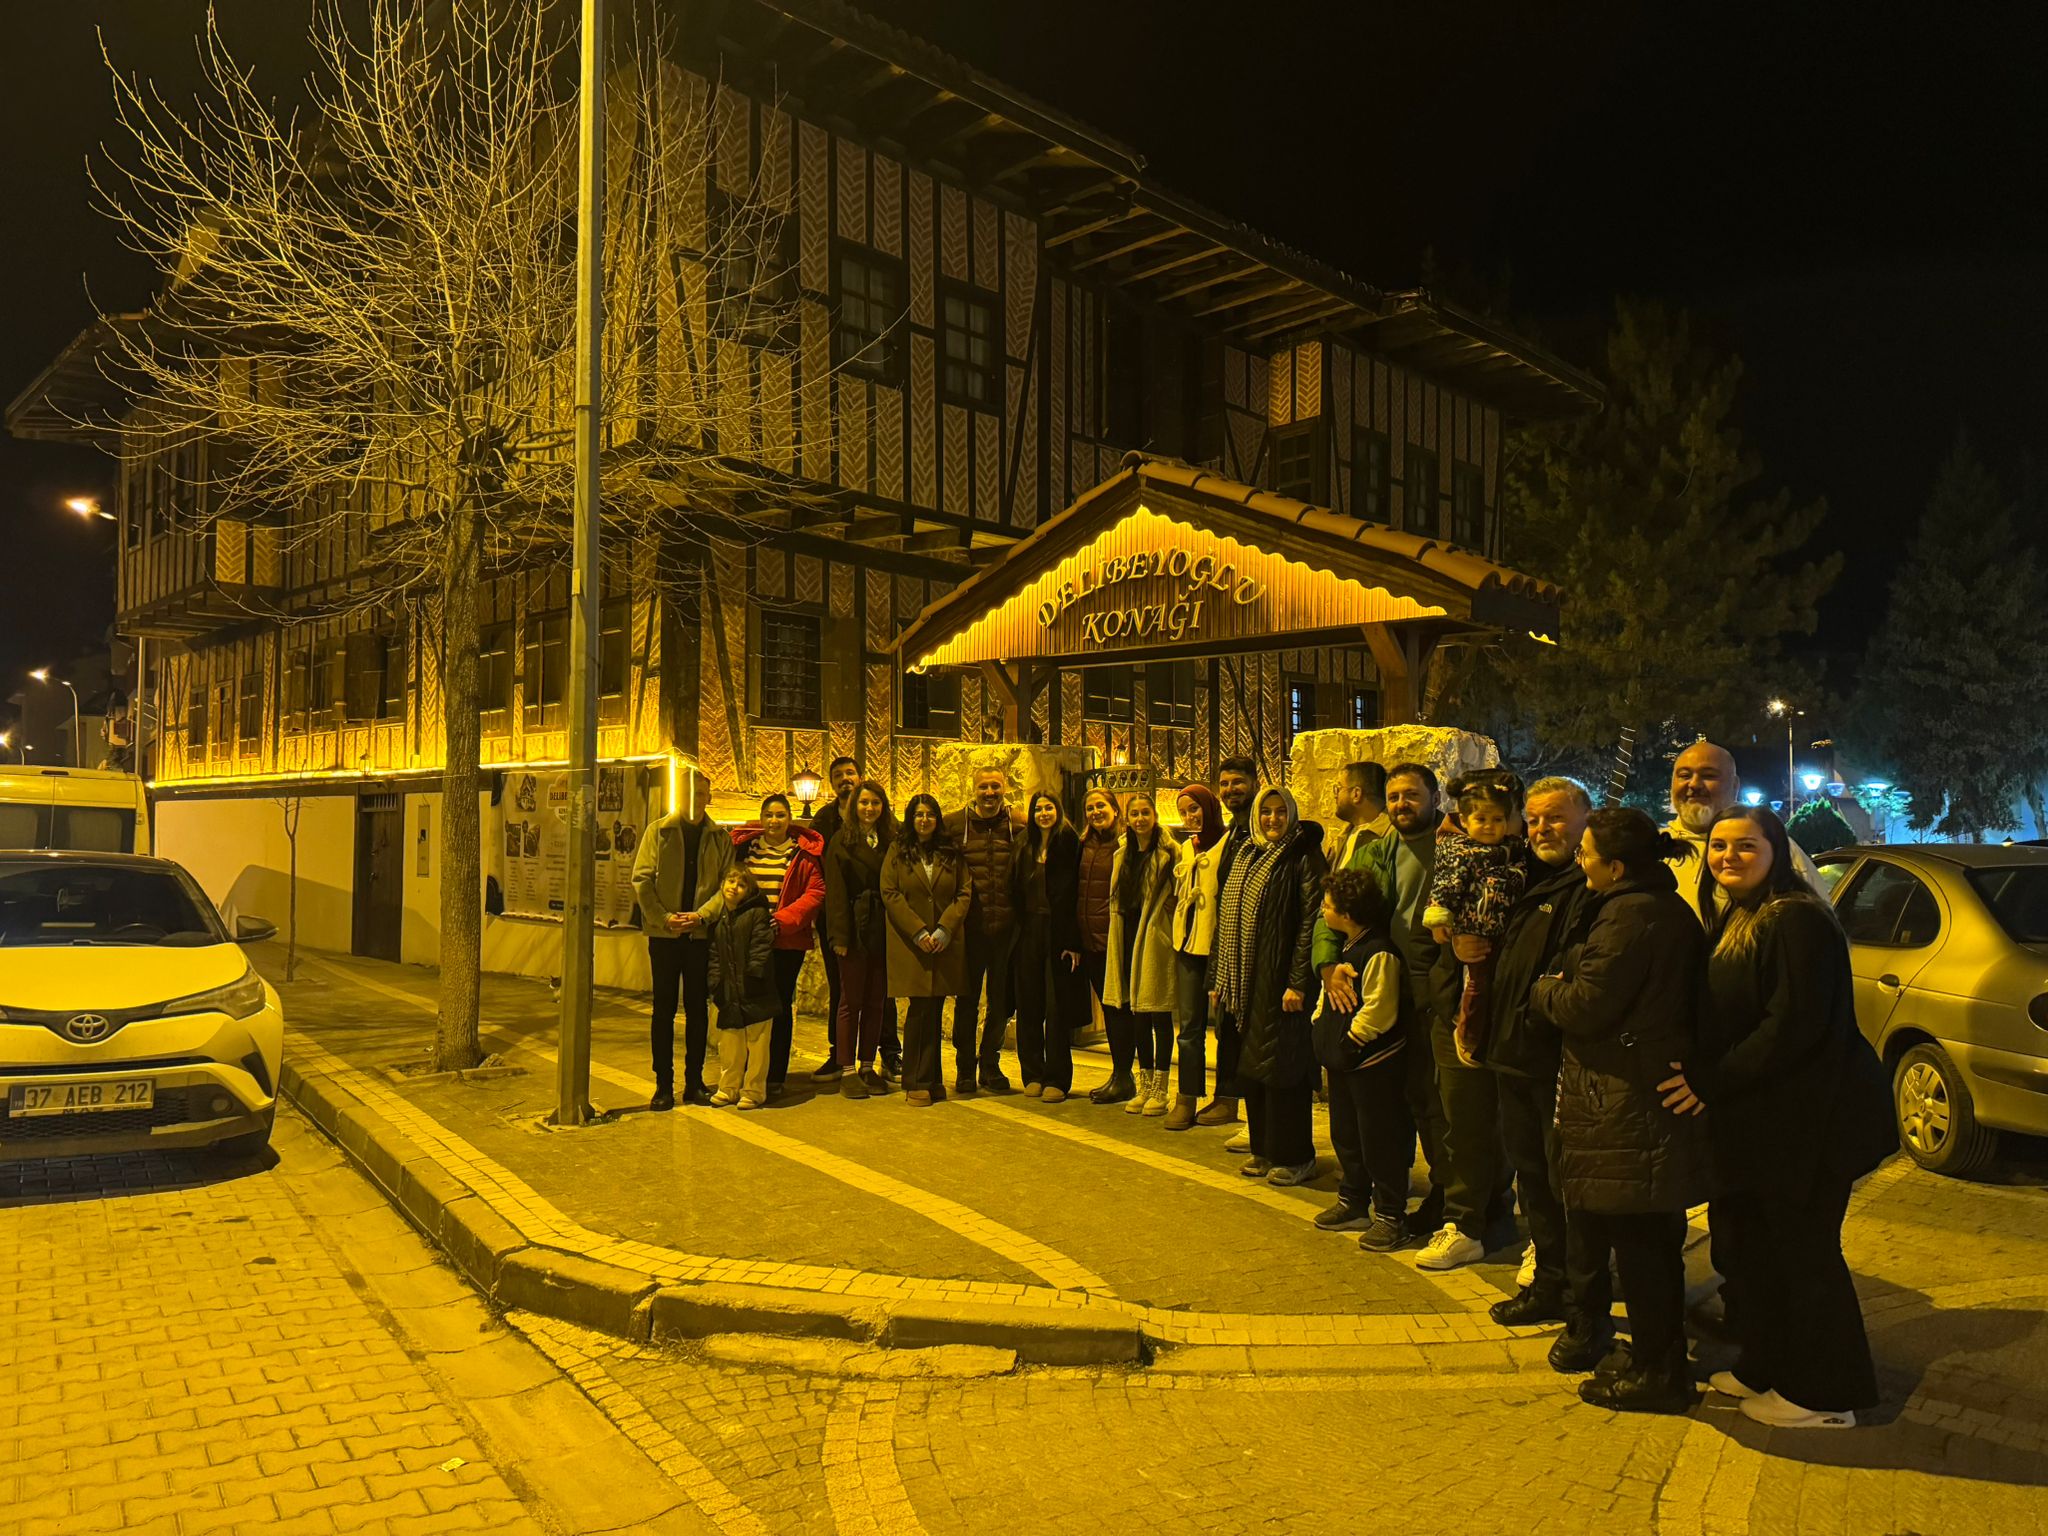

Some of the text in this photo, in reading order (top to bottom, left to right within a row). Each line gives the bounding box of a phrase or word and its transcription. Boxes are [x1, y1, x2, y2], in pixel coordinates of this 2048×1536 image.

[1037, 545, 1267, 629] DELİBEYOĞLU
[1082, 592, 1204, 644] KONAĞI
[26, 1082, 148, 1108] 37 AEB 212
